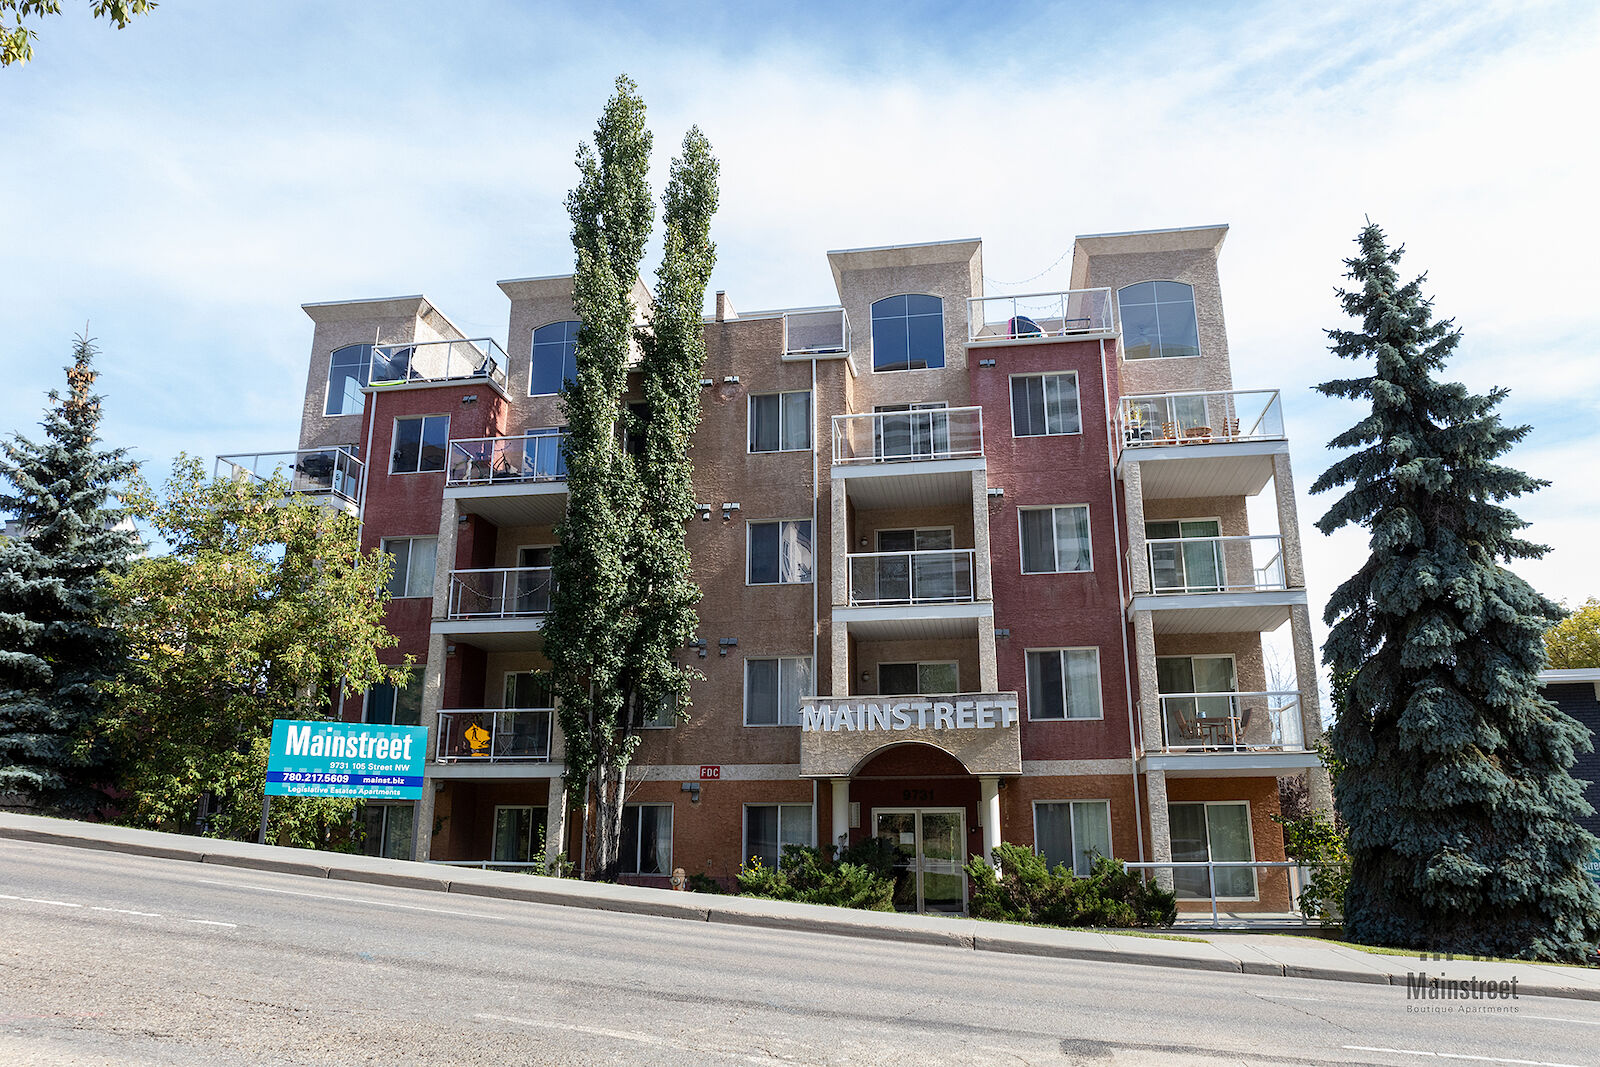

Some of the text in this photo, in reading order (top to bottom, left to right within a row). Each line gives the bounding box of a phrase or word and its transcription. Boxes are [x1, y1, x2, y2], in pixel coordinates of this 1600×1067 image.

[802, 700, 1017, 732] MAINSTREET
[285, 725, 412, 760] Mainstreet
[367, 763, 393, 771] Street
[701, 768, 719, 777] FDC
[282, 772, 349, 783] 780.217.5609
[287, 786, 329, 794] Legislative
[330, 786, 357, 795] Estates
[903, 789, 934, 801] 9731
